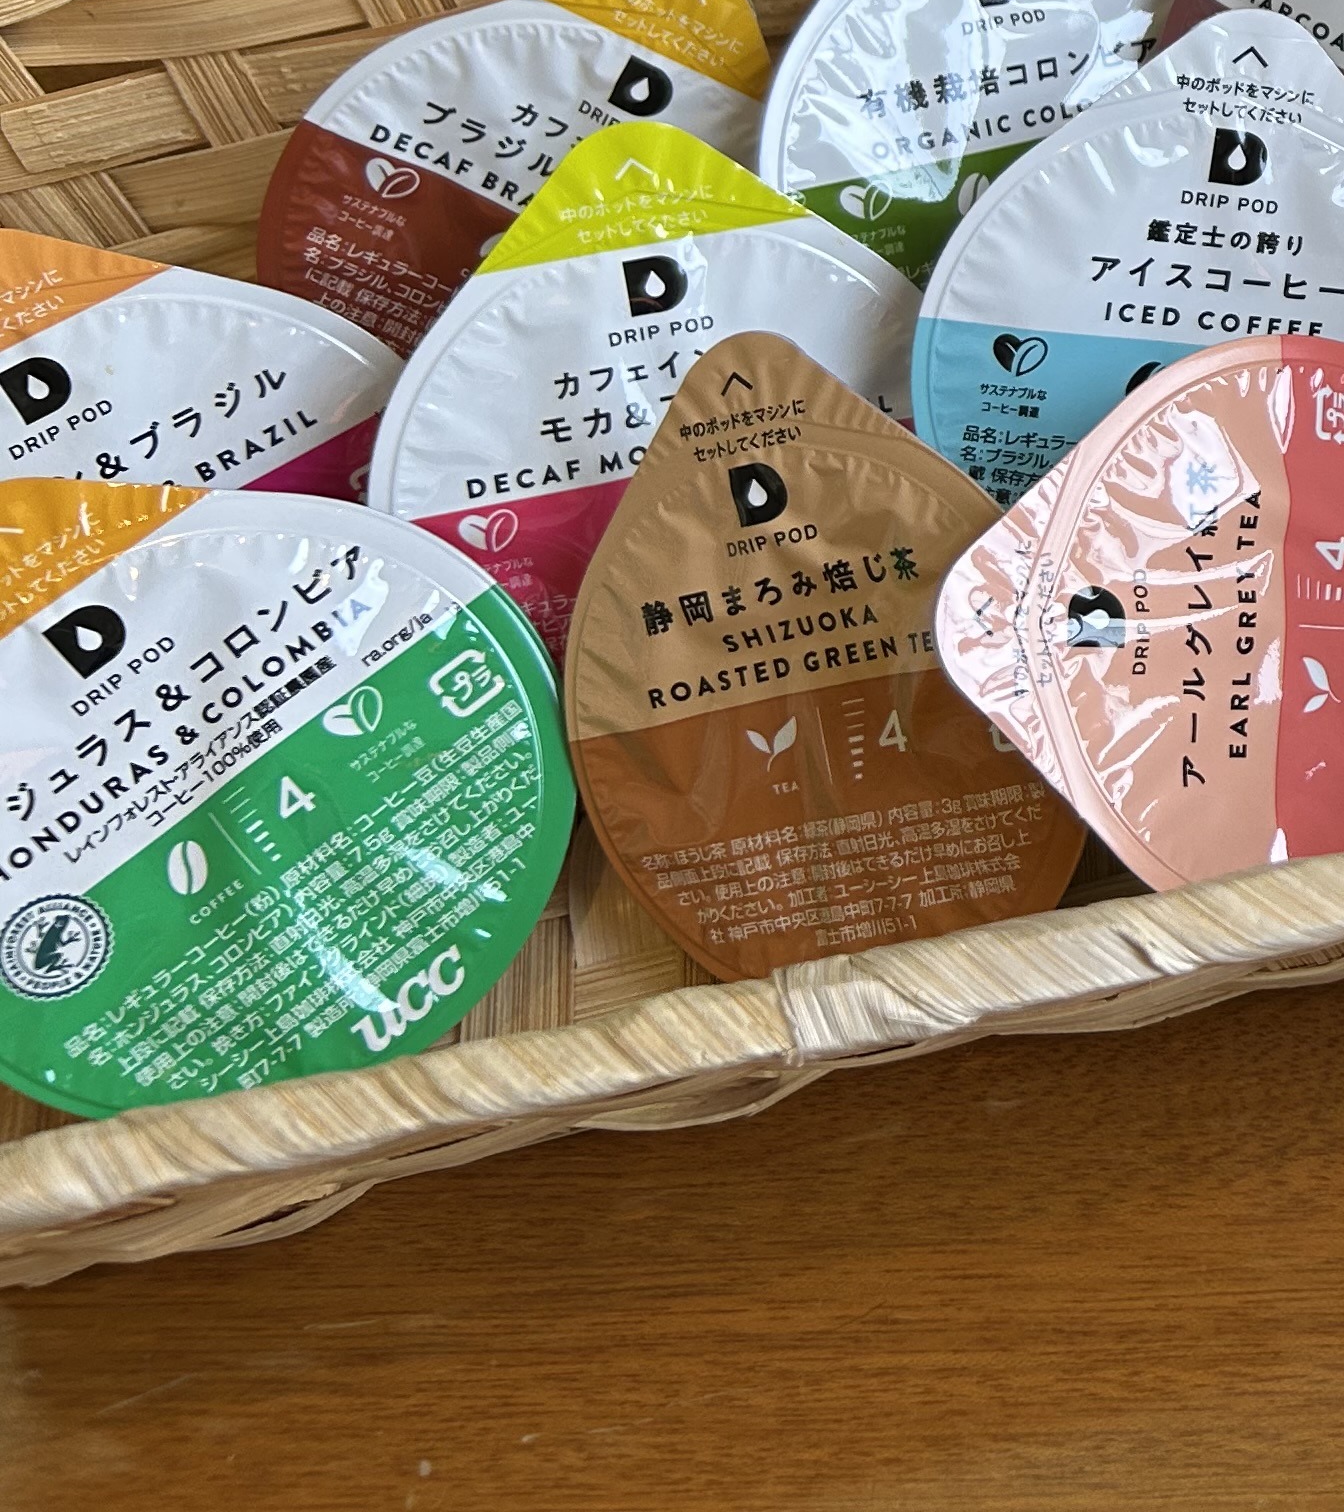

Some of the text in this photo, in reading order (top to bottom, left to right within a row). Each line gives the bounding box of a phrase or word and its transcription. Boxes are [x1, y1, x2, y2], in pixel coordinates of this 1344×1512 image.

[961, 8, 1047, 37] DRIP POD
[859, 35, 1159, 122] 有機栽培コロンビア
[1176, 74, 1315, 108] 中のポッドをマシンに
[1182, 97, 1302, 126] セットしてください
[369, 124, 474, 176] DECAF
[421, 100, 554, 178] ブラジル
[871, 114, 1013, 161] ORGANIC
[1180, 190, 1279, 216] DRIP POD
[1146, 219, 1305, 257] 鑑定士の誇り
[608, 315, 714, 348] DRIP POD
[1104, 301, 1181, 327] ICED
[553, 350, 704, 400] カフェイ
[979, 383, 1048, 402] サステナブルな
[7, 399, 114, 461] DRIP POD
[678, 398, 807, 441] 中のポッドをマシンに
[981, 401, 1040, 419] コーヒー調達
[194, 410, 320, 484] BRAZIL
[692, 425, 803, 464] セットしてください
[466, 458, 580, 500] DECAF
[725, 523, 819, 558] DRIP POD
[640, 546, 921, 639] 静岡まろみ焙じ茶
[359, 607, 433, 669] ra.org/ja
[722, 602, 880, 655] SHIZUOKA
[1130, 567, 1148, 676] DRIP POD
[1181, 460, 1222, 789] アールグレイ紅茶
[1229, 488, 1262, 760] EARL GREY TEA
[70, 635, 178, 718] DRIP POD
[178, 719, 202, 746] &
[197, 590, 372, 728] COLOMBIA
[647, 657, 791, 711] ROASTED
[803, 635, 899, 675] GREEN
[878, 709, 909, 755] 4
[143, 715, 284, 828] コーヒー100%使用
[263, 768, 321, 821] 4
[772, 780, 800, 796] TEA
[63, 700, 524, 1058] 品名:レギュラーコーヒー(粉) 原材料名:コーヒー豆(生豆生産国
[187, 877, 245, 927] COFFEE
[85, 900, 295, 1069] 名:ホンジュラス、コロンビア)
[164, 1048, 214, 1092] さい。
